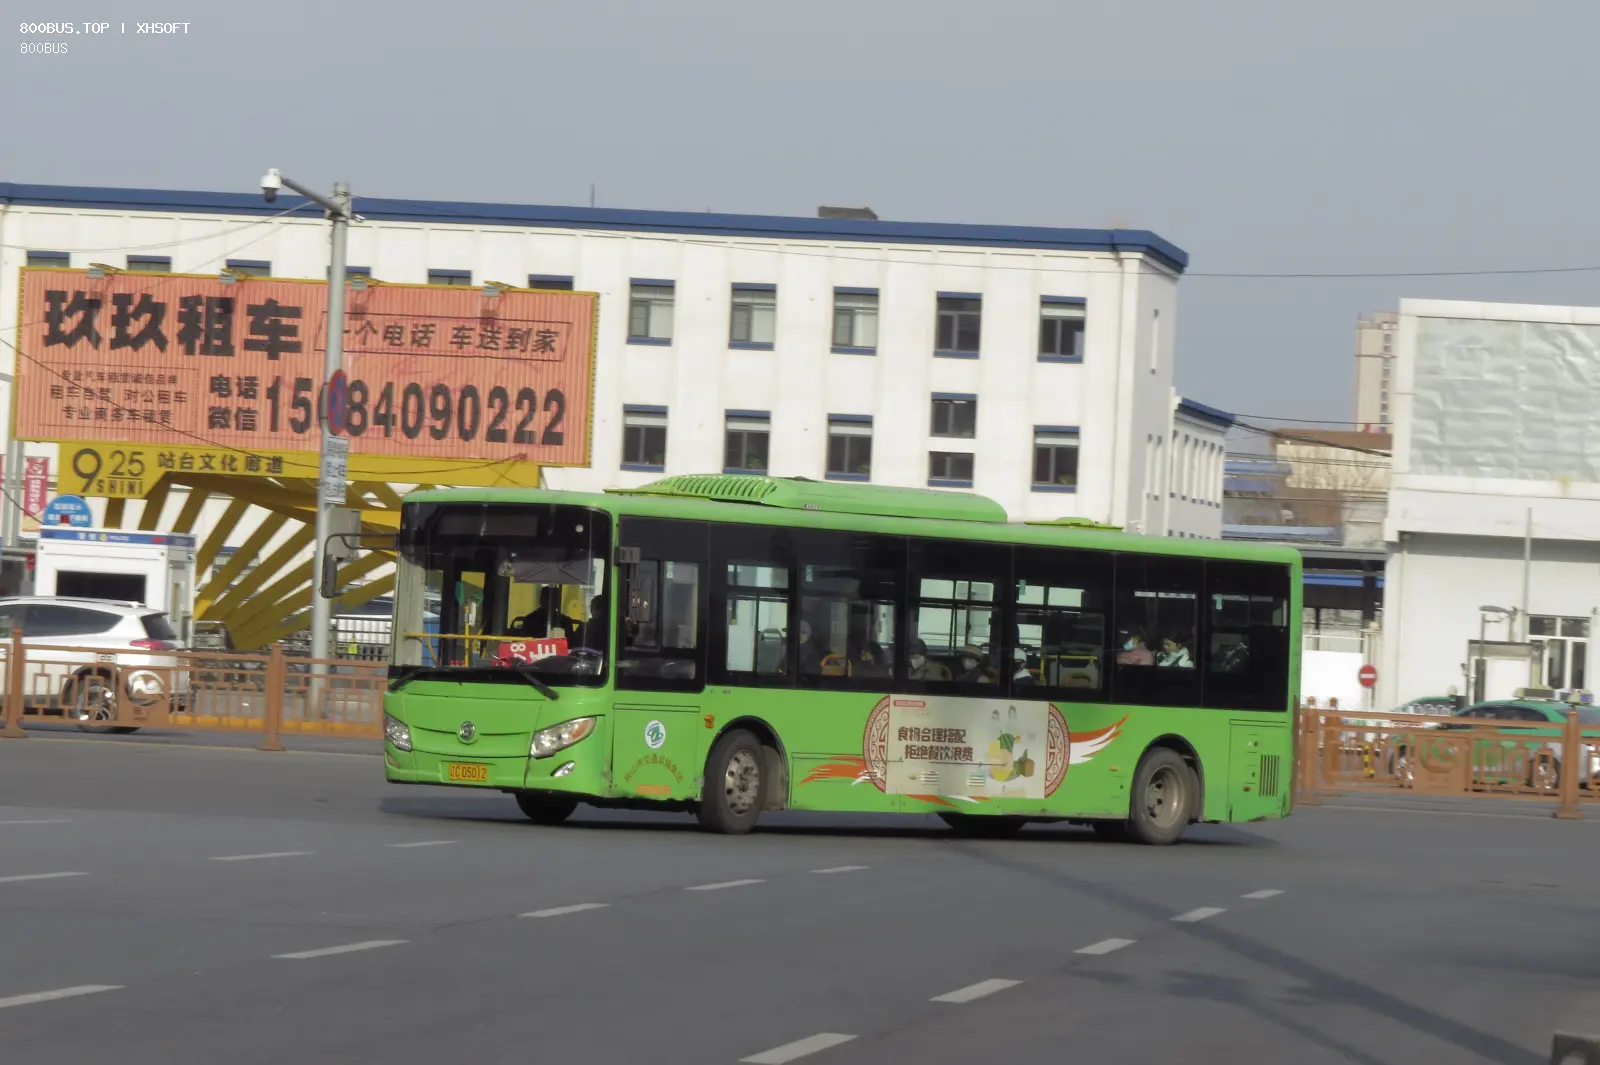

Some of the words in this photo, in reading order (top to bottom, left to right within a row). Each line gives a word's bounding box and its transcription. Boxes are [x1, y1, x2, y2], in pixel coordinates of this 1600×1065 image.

[43, 289, 302, 360] 玖玖租车
[342, 320, 436, 348] 个电话
[449, 324, 560, 354] 车送到家
[210, 373, 260, 399] 电话
[208, 405, 259, 432] 微信
[266, 374, 566, 446] 1584090222
[898, 726, 966, 744] 食物合理搭配
[904, 744, 974, 761] 拒绝餐饮浪费
